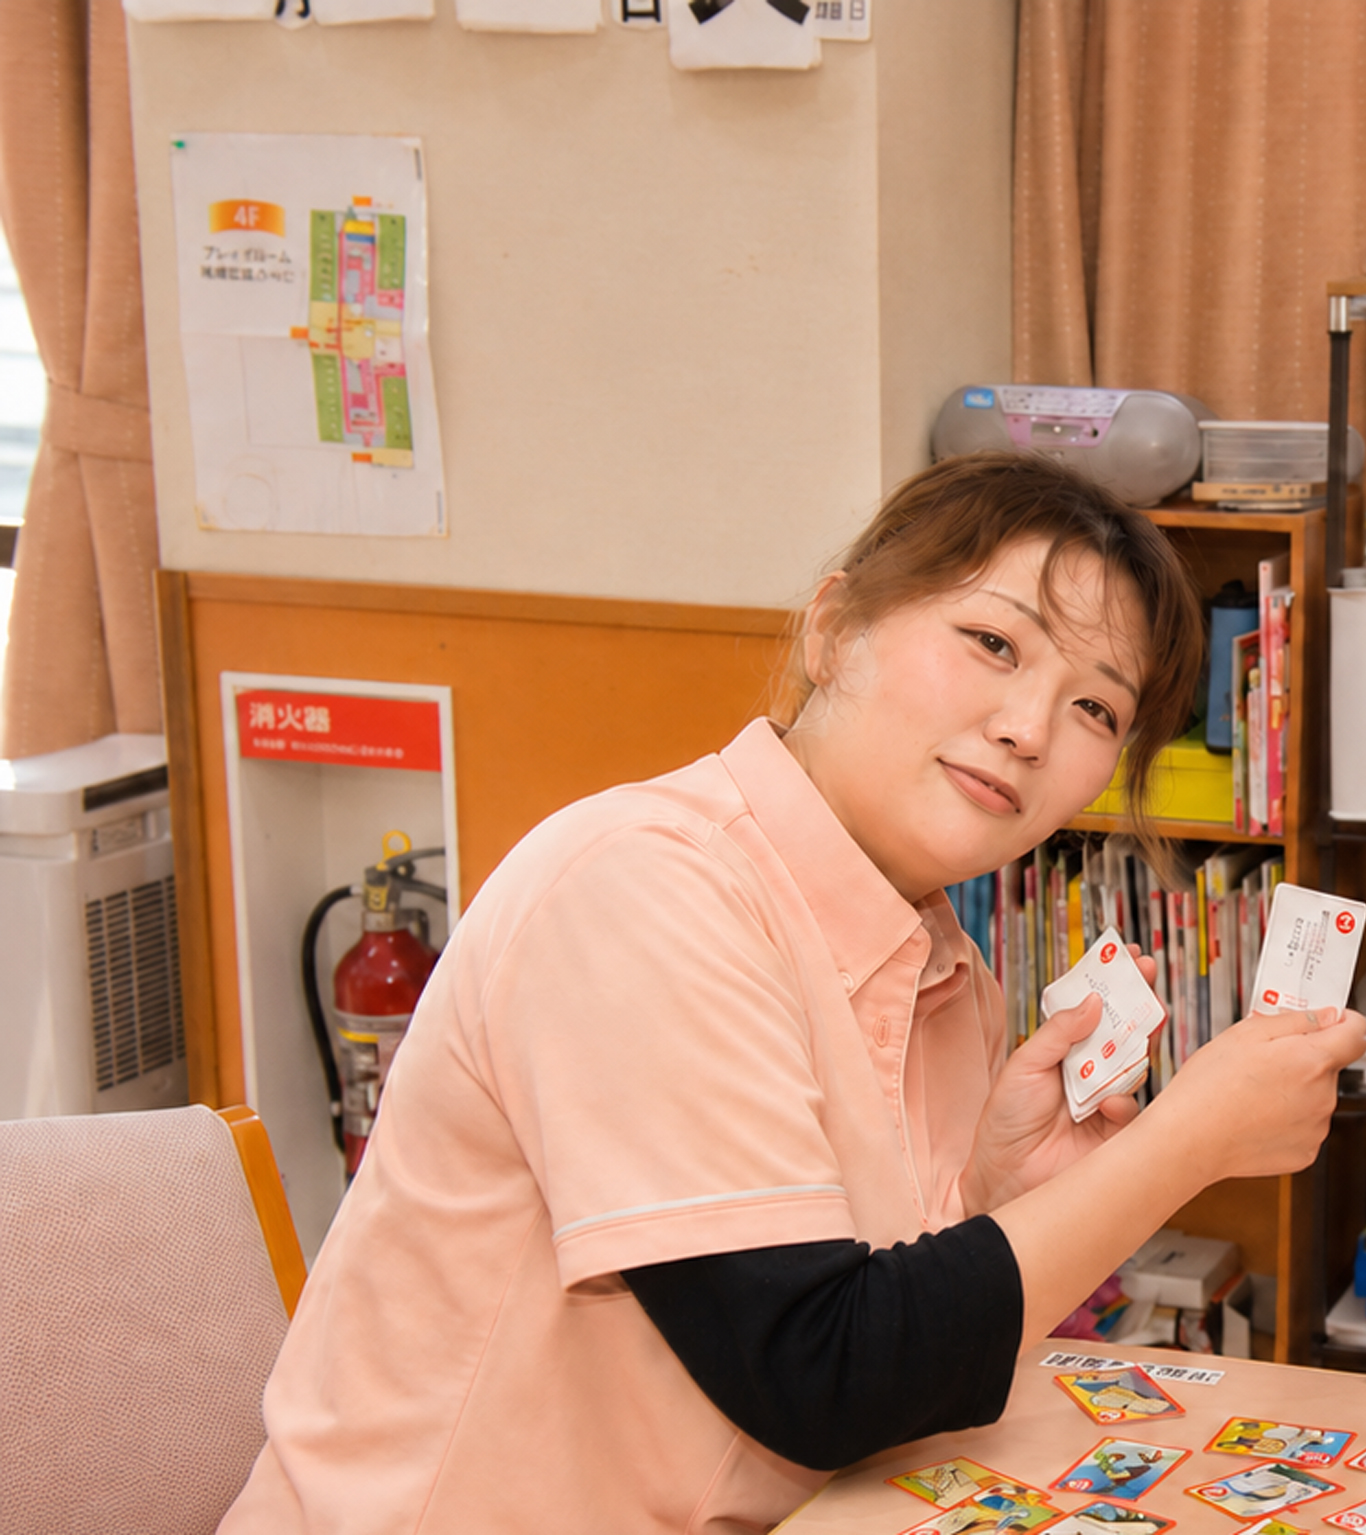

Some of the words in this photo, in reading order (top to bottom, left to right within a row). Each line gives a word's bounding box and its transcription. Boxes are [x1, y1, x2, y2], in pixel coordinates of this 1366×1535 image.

[234, 205, 260, 228] 4F
[250, 702, 331, 733] 消火器
